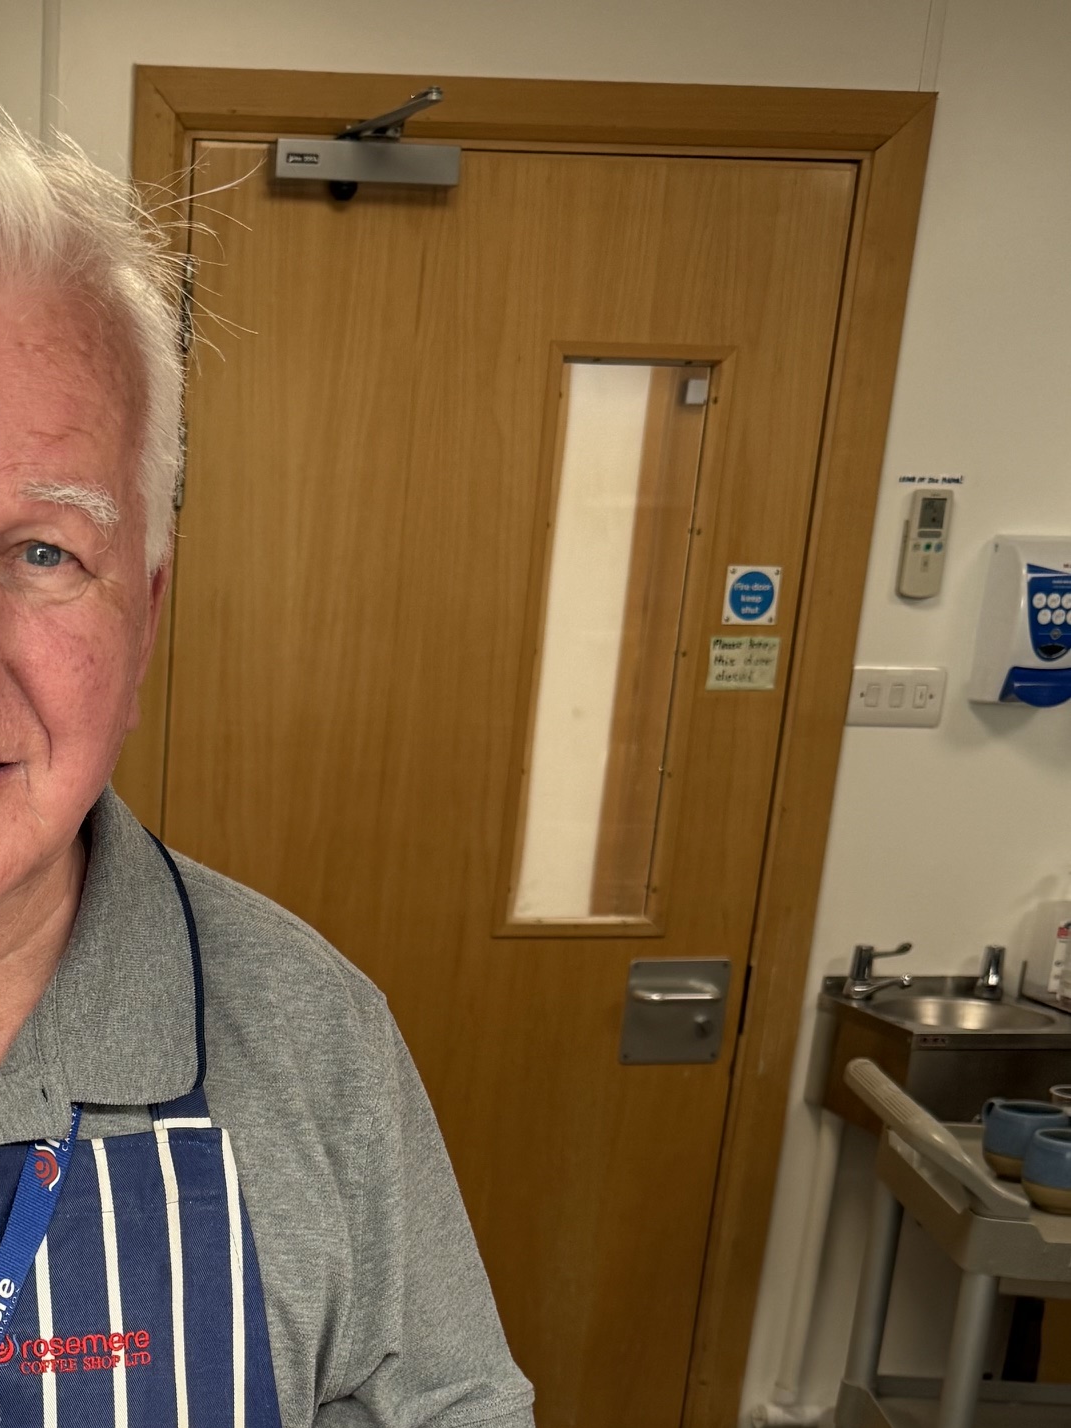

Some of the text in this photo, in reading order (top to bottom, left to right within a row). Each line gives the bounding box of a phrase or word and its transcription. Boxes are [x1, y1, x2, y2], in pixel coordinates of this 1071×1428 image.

[752, 581, 773, 592] door
[741, 595, 763, 605] keep
[741, 605, 760, 614] shut
[21, 1329, 151, 1358] rosemere
[19, 1350, 151, 1375] COFFEE SHOP LTD
